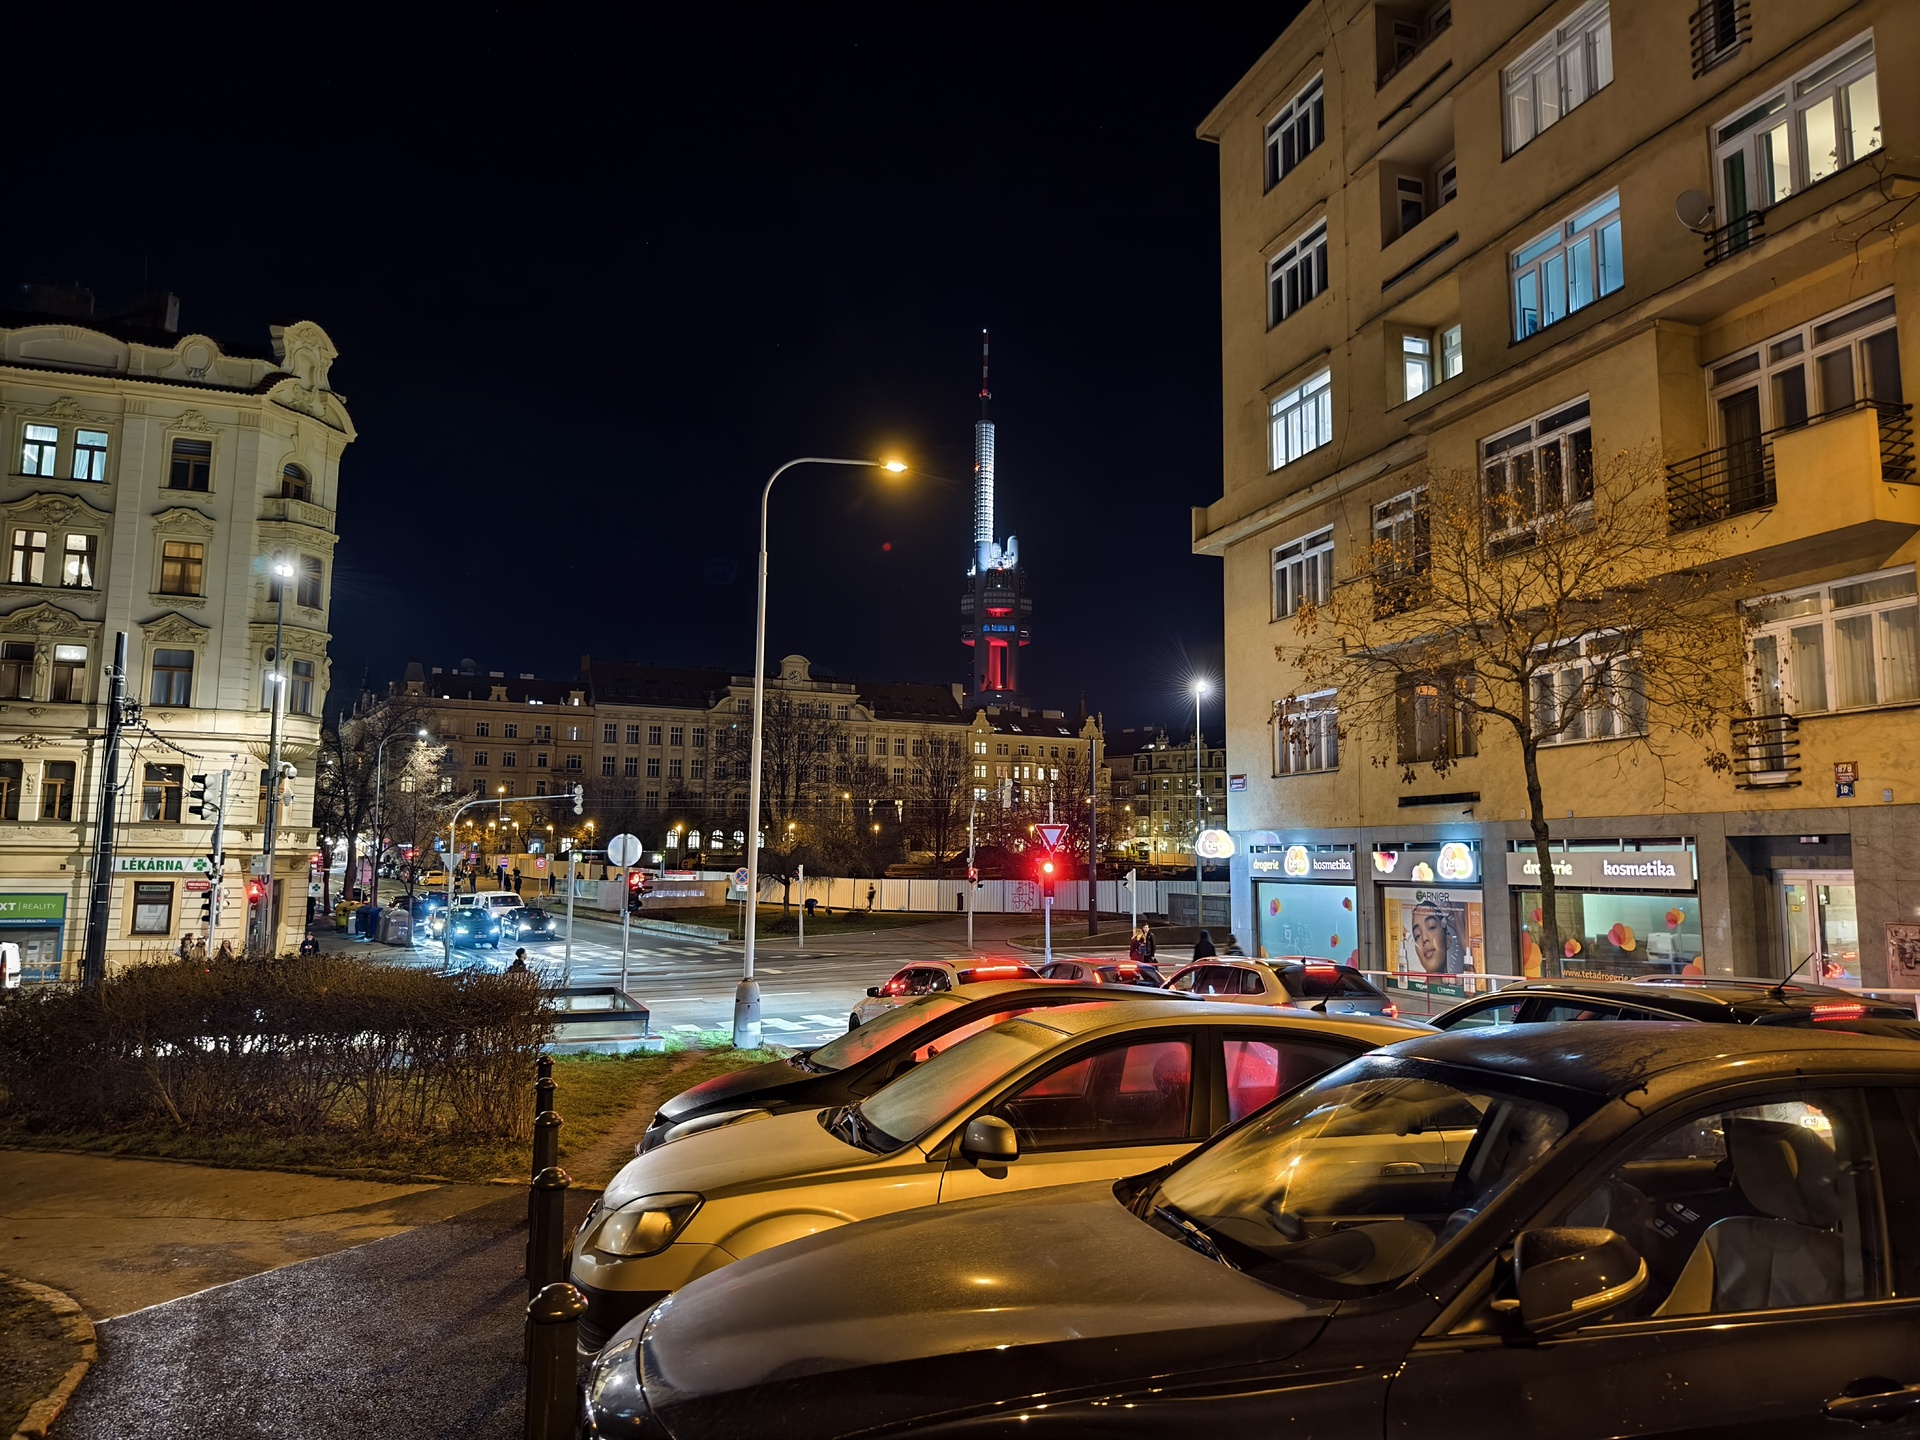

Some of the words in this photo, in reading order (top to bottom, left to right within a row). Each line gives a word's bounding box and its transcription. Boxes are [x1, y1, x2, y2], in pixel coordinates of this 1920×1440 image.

[121, 858, 184, 871] LÉKÁRNA
[1253, 859, 1279, 872] drogerie
[1313, 858, 1352, 870] kosmetika
[1523, 859, 1573, 876] droerie
[1603, 859, 1676, 877] kosmetika
[1416, 890, 1450, 901] GARNIER
